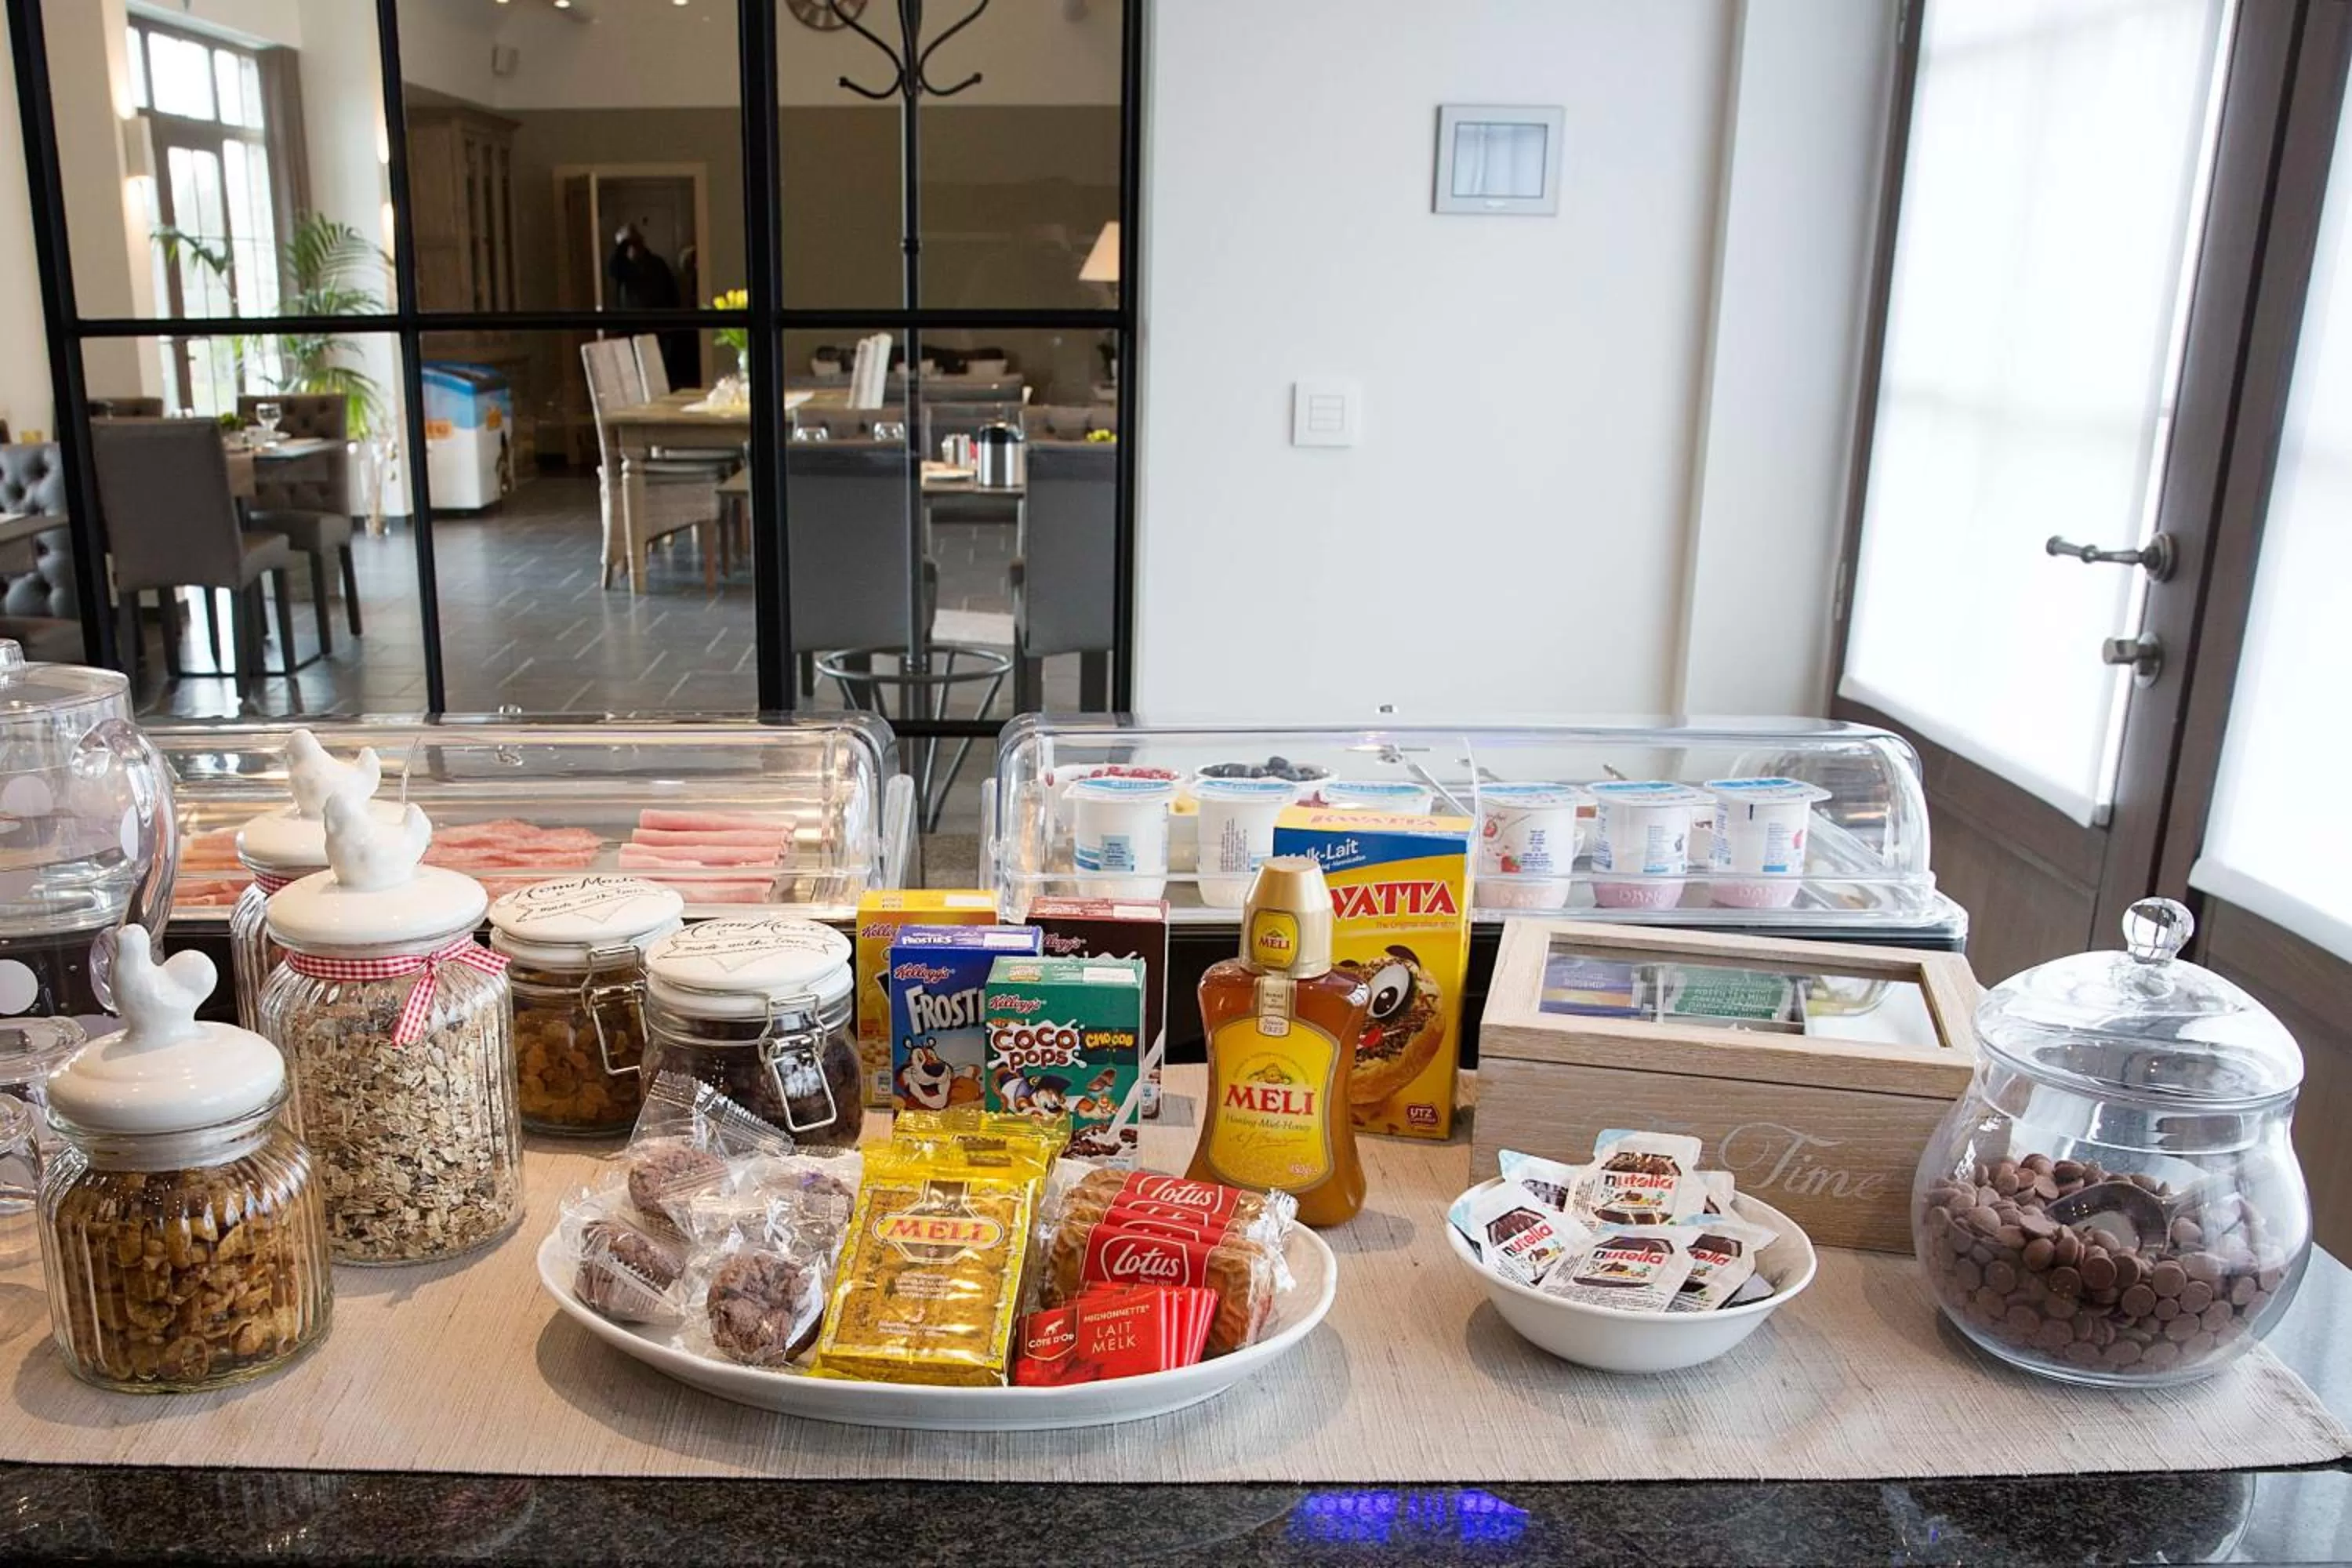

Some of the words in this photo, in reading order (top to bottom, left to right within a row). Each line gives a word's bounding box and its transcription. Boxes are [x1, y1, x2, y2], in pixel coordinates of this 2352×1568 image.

[1259, 936, 1290, 950] MELI
[905, 984, 985, 1036] FROSTI
[992, 1026, 1079, 1052] COCO
[1223, 1084, 1316, 1116] MELI
[1604, 1174, 1674, 1190] nutella
[887, 1219, 985, 1241] MELI
[1501, 1224, 1554, 1258] nutella
[1592, 1247, 1664, 1265] nutella
[1097, 1320, 1132, 1338] LAIT
[1091, 1335, 1137, 1355] MELK
